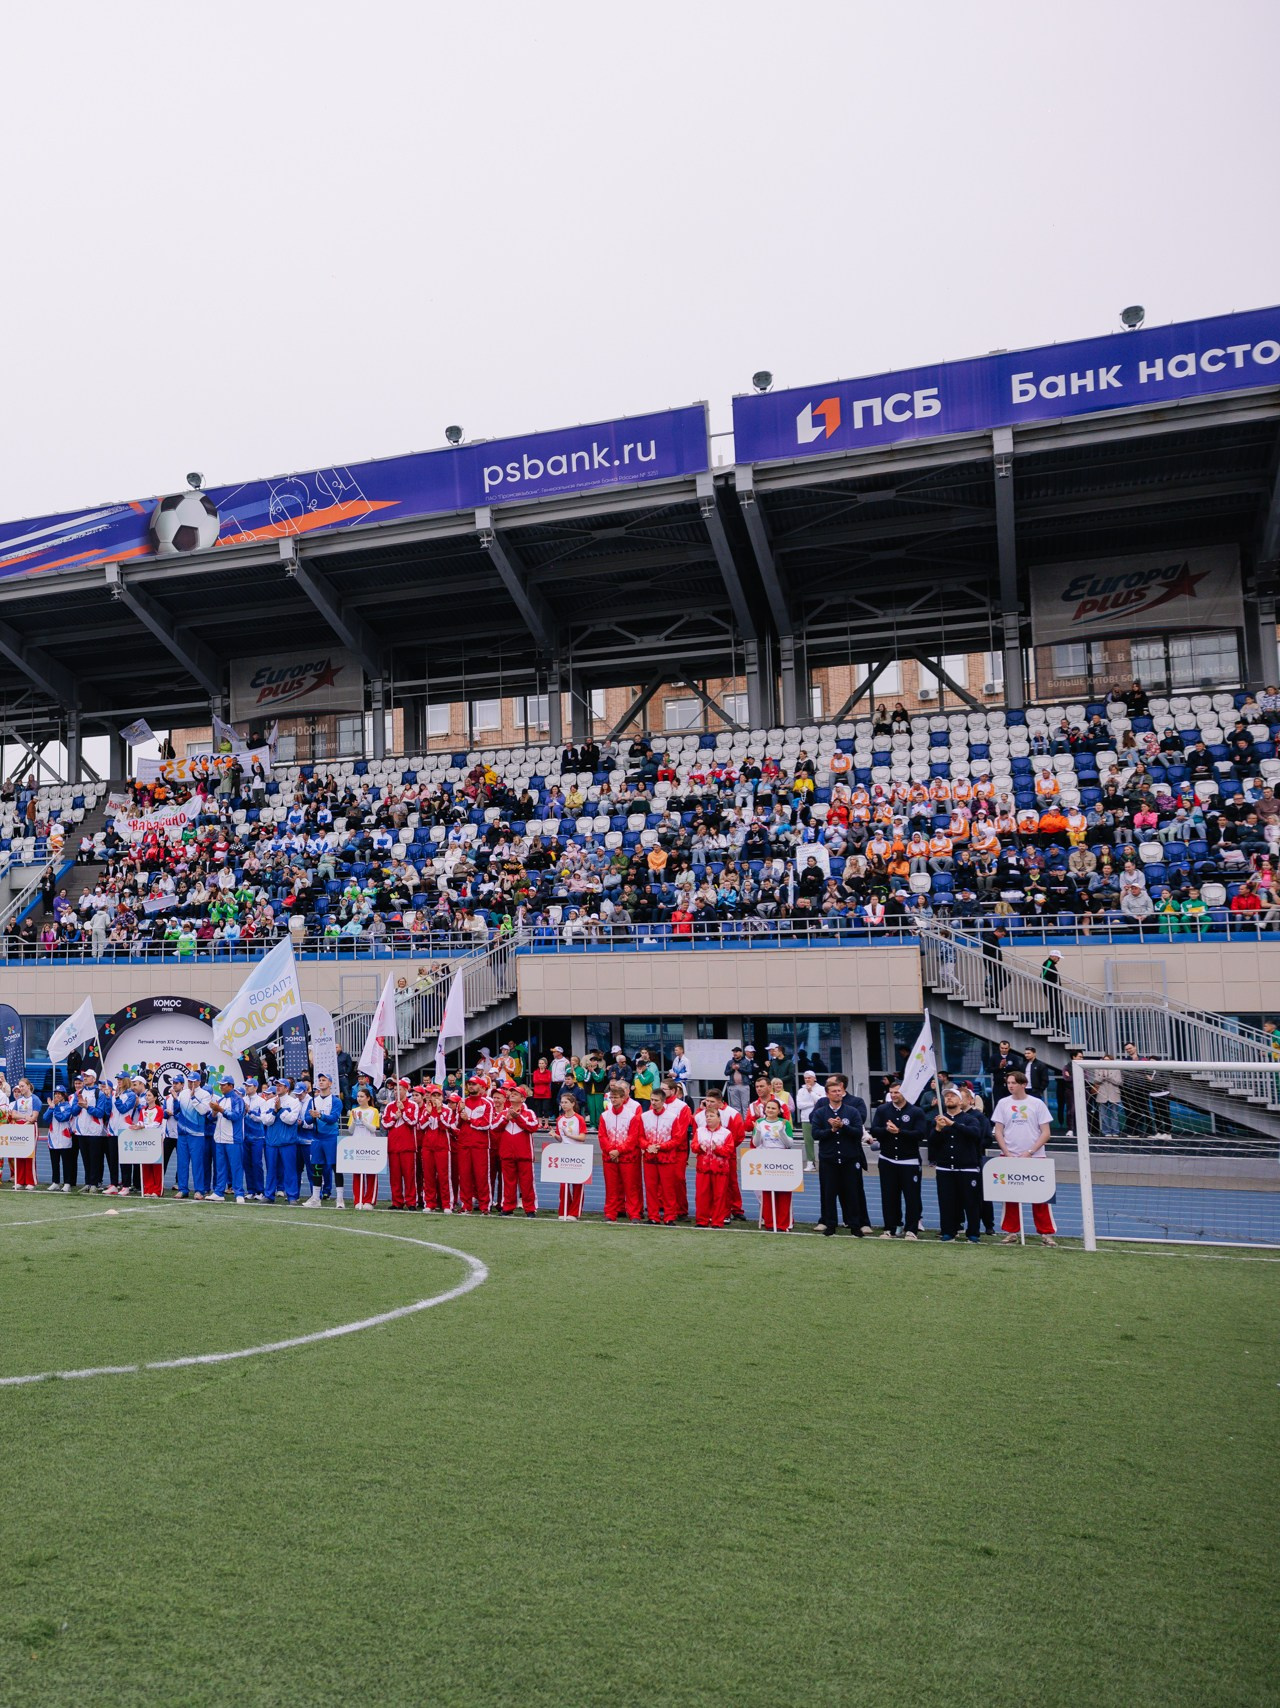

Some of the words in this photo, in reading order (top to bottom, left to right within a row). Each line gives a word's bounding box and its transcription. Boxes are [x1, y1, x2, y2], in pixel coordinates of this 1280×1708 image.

[1011, 364, 1124, 404] Банк
[853, 387, 942, 430] ПСБ
[483, 439, 656, 493] psbank.ru
[1131, 643, 1189, 660] РОССИИ
[1048, 678, 1085, 688] БОЛЬШЕ
[1086, 676, 1118, 686] ХИТОВ!
[292, 724, 328, 736] РОССИИ
[1008, 1174, 1045, 1182] КОМОС
